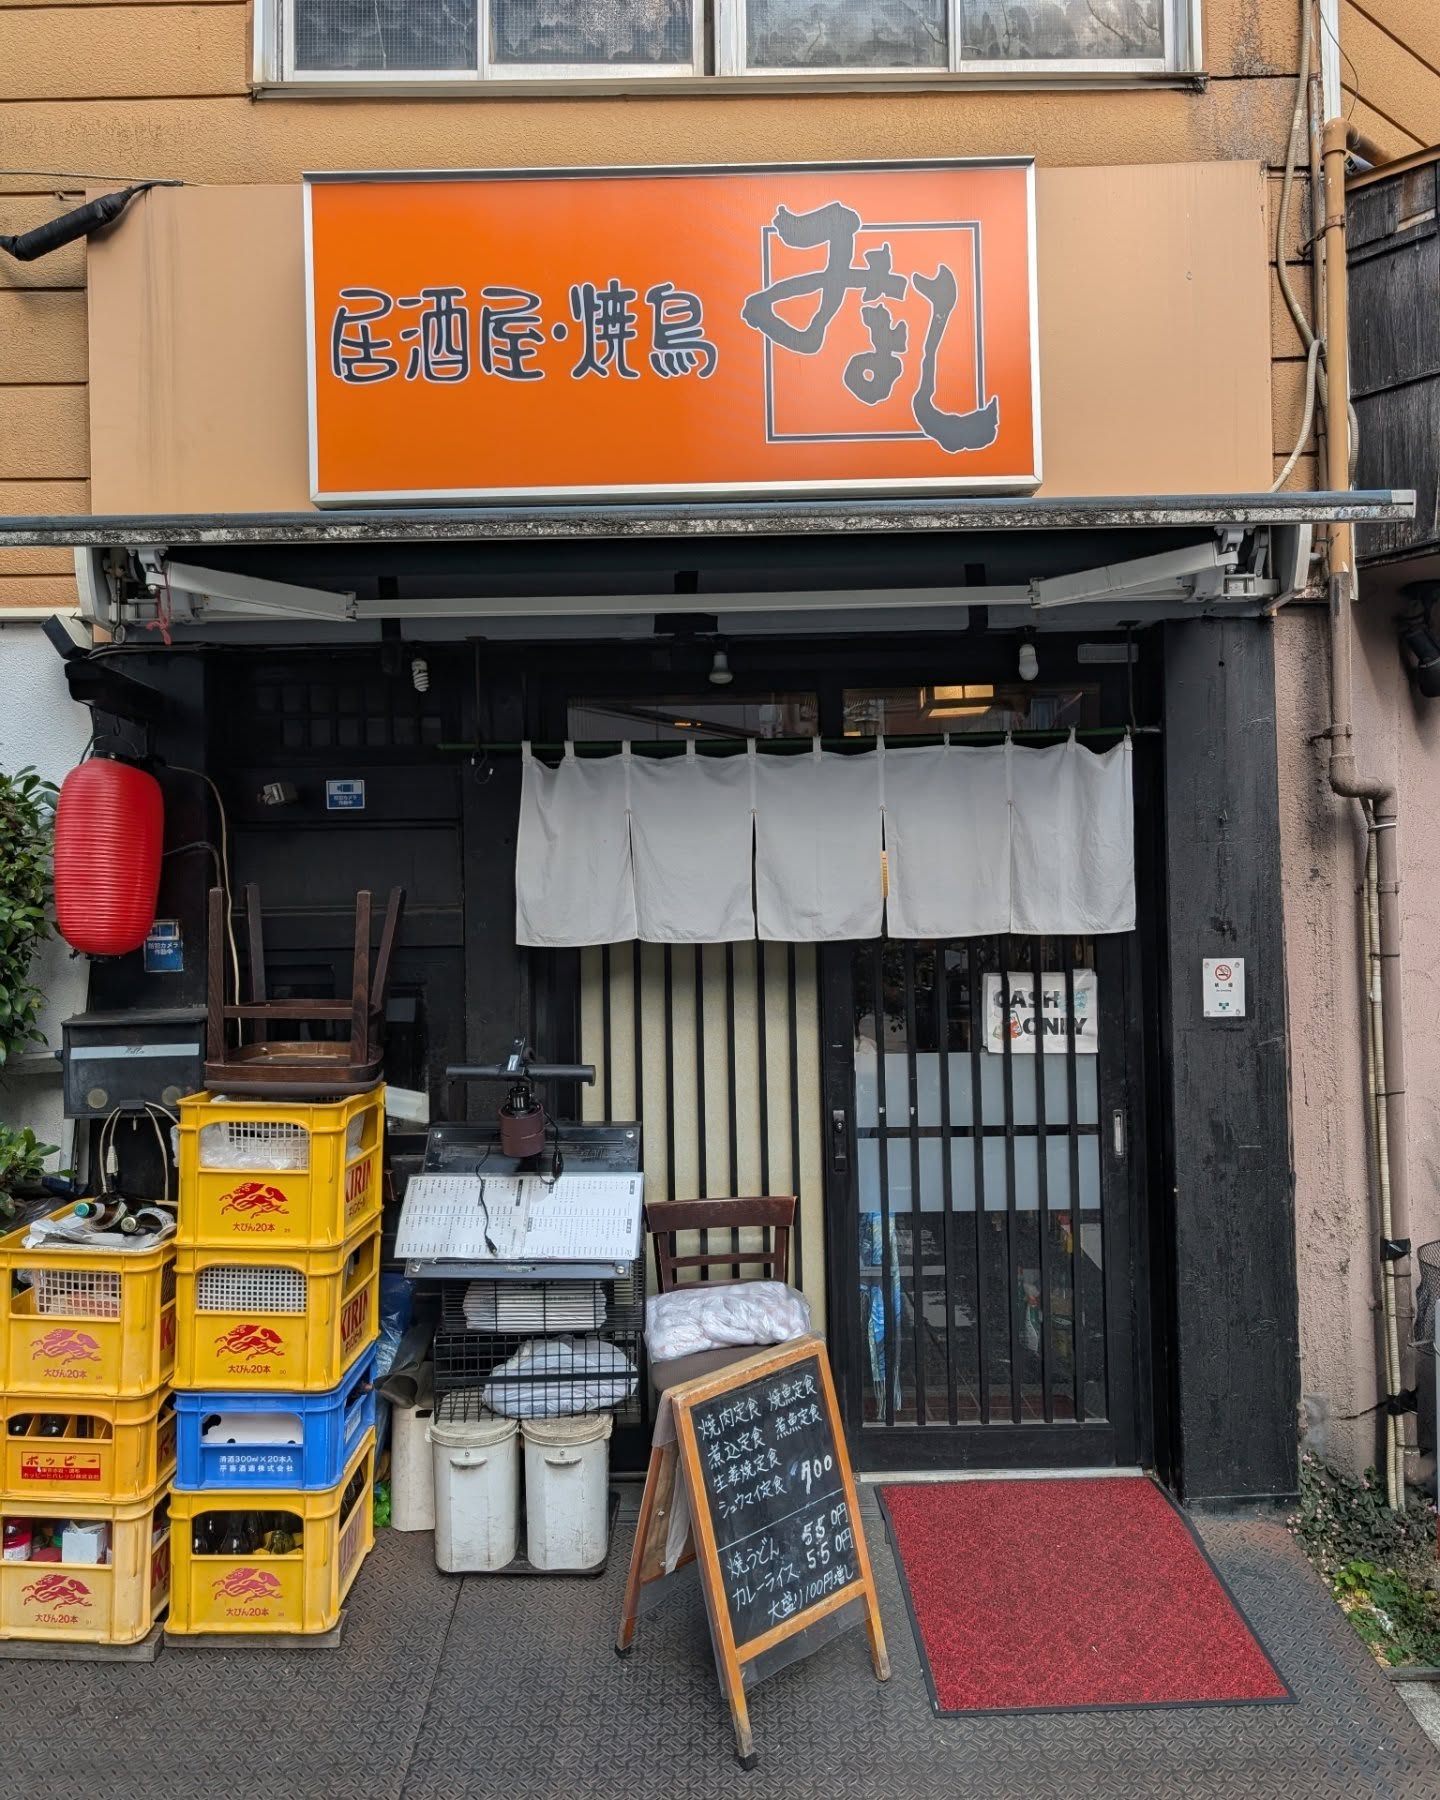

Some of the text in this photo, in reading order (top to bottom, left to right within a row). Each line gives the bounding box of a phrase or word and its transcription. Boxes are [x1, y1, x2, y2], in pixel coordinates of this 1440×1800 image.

[331, 278, 718, 385] 居酒屋・焼鳥
[232, 1222, 276, 1233] 大びん20本
[43, 1368, 88, 1379] 大びん20本
[227, 1364, 272, 1375] 大びん20本
[726, 1536, 780, 1581] 焼うどん
[732, 1562, 800, 1612] カレーライス
[225, 1607, 270, 1617] 大びん20本
[34, 1613, 79, 1624] 大びん20本
